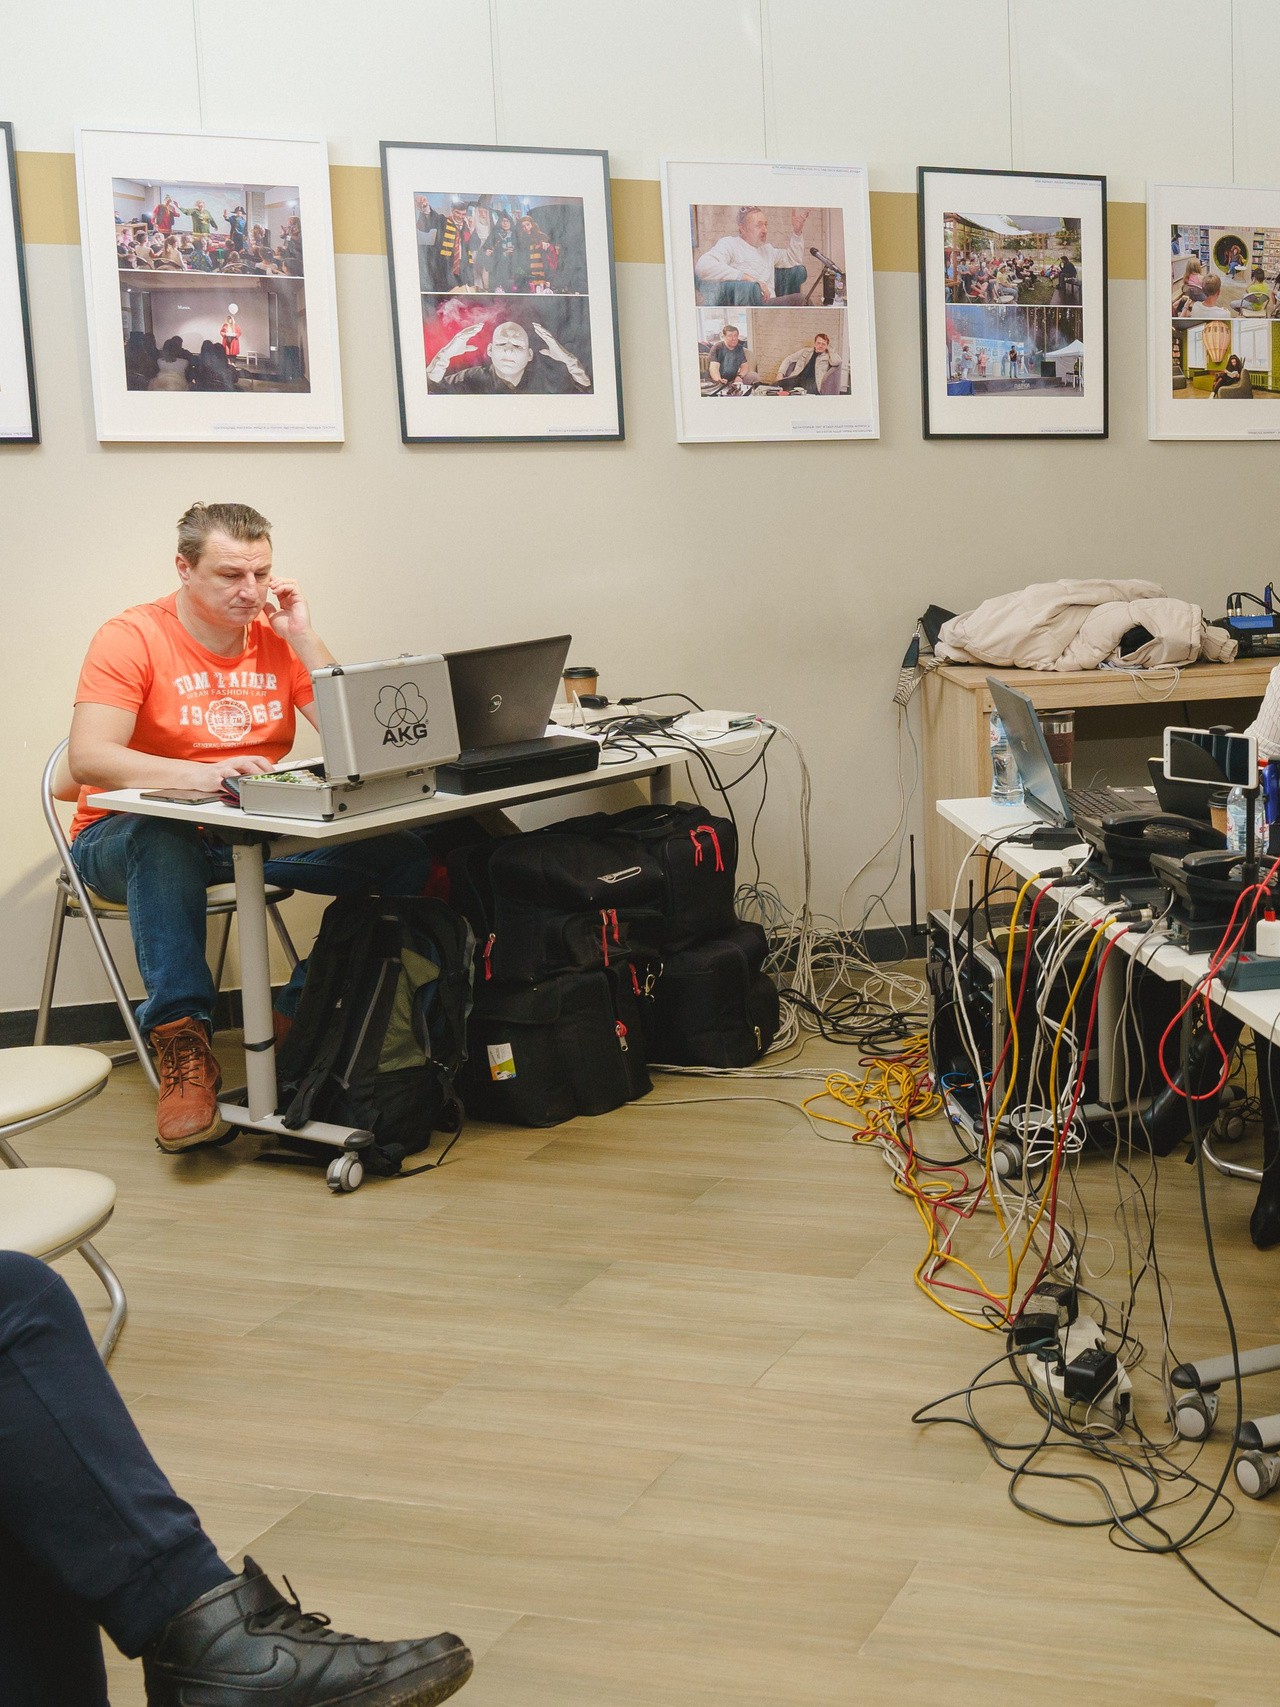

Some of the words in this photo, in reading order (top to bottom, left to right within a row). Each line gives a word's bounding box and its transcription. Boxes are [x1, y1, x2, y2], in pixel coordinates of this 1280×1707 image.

[174, 671, 211, 695] TOM
[211, 689, 249, 697] FASHION
[179, 705, 203, 726] 19
[252, 700, 284, 725] 62
[382, 723, 428, 746] AKG
